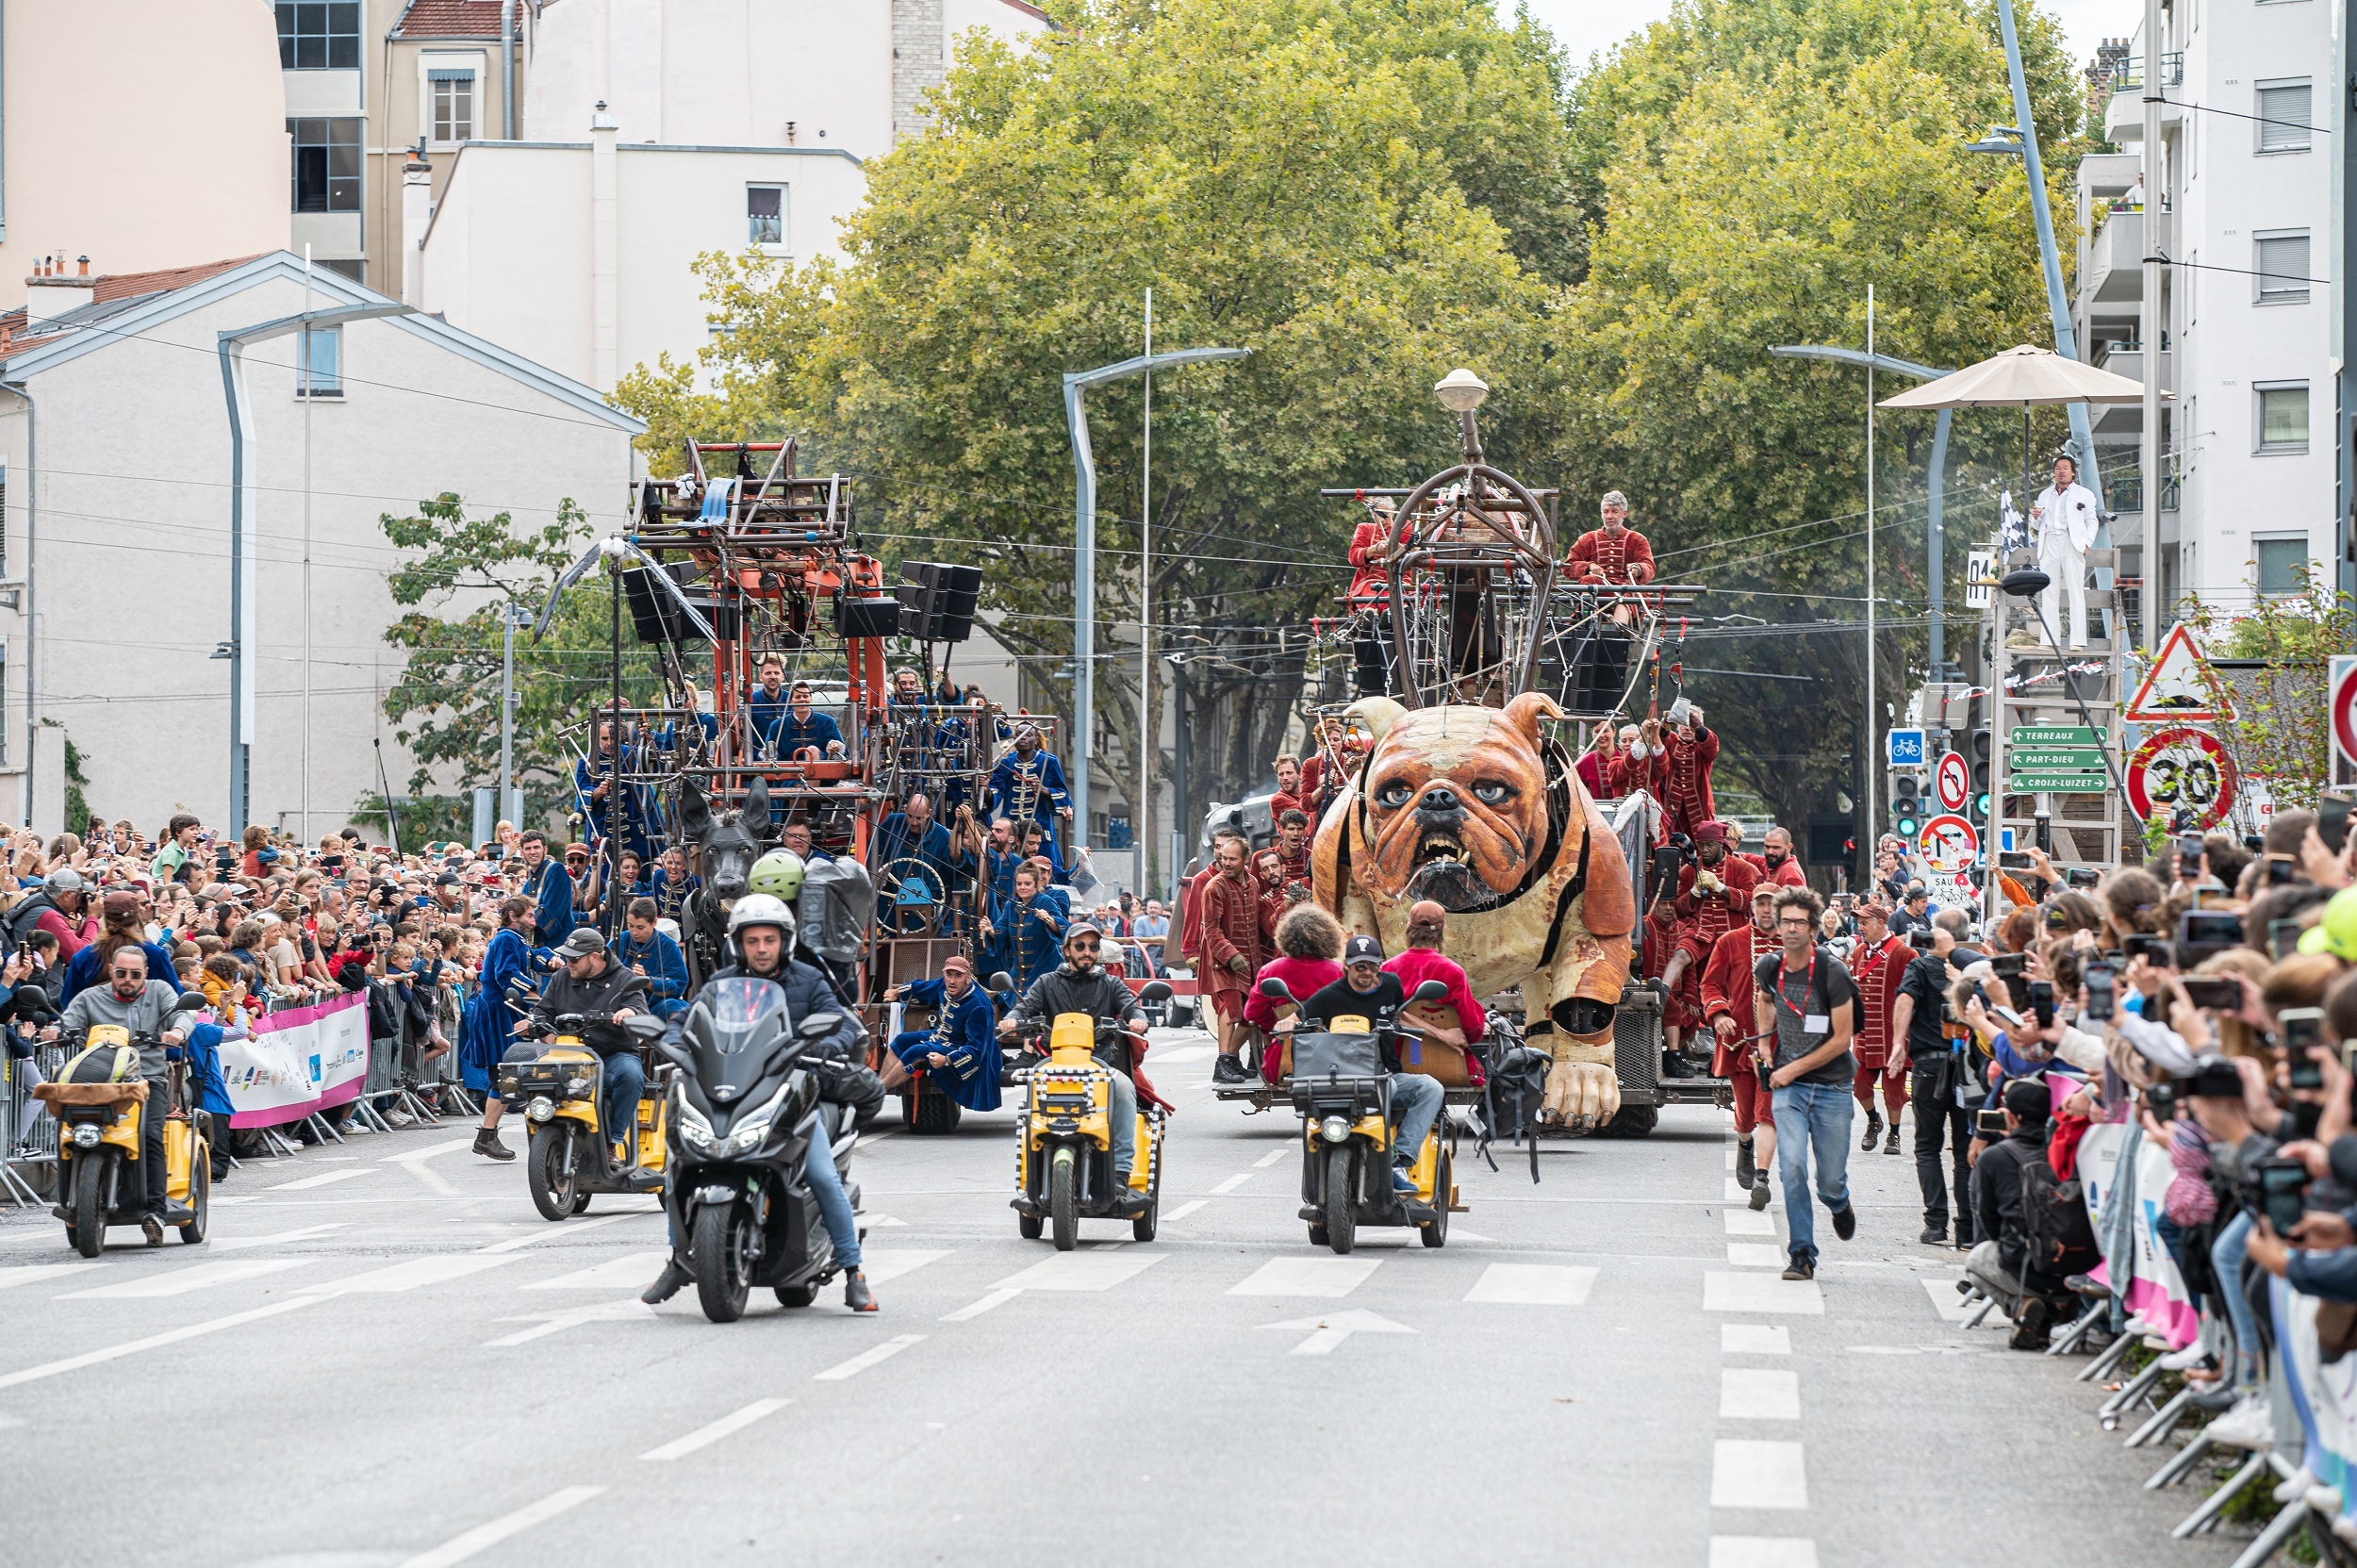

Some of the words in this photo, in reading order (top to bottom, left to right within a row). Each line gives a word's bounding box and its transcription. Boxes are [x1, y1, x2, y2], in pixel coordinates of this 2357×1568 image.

[2026, 732, 2074, 740] TERREAUX
[2026, 755, 2074, 764] PART-DIEU
[2028, 779, 2092, 787] CROIX-LUIZET
[2151, 759, 2217, 804] 30
[1935, 878, 1953, 886] SAU
